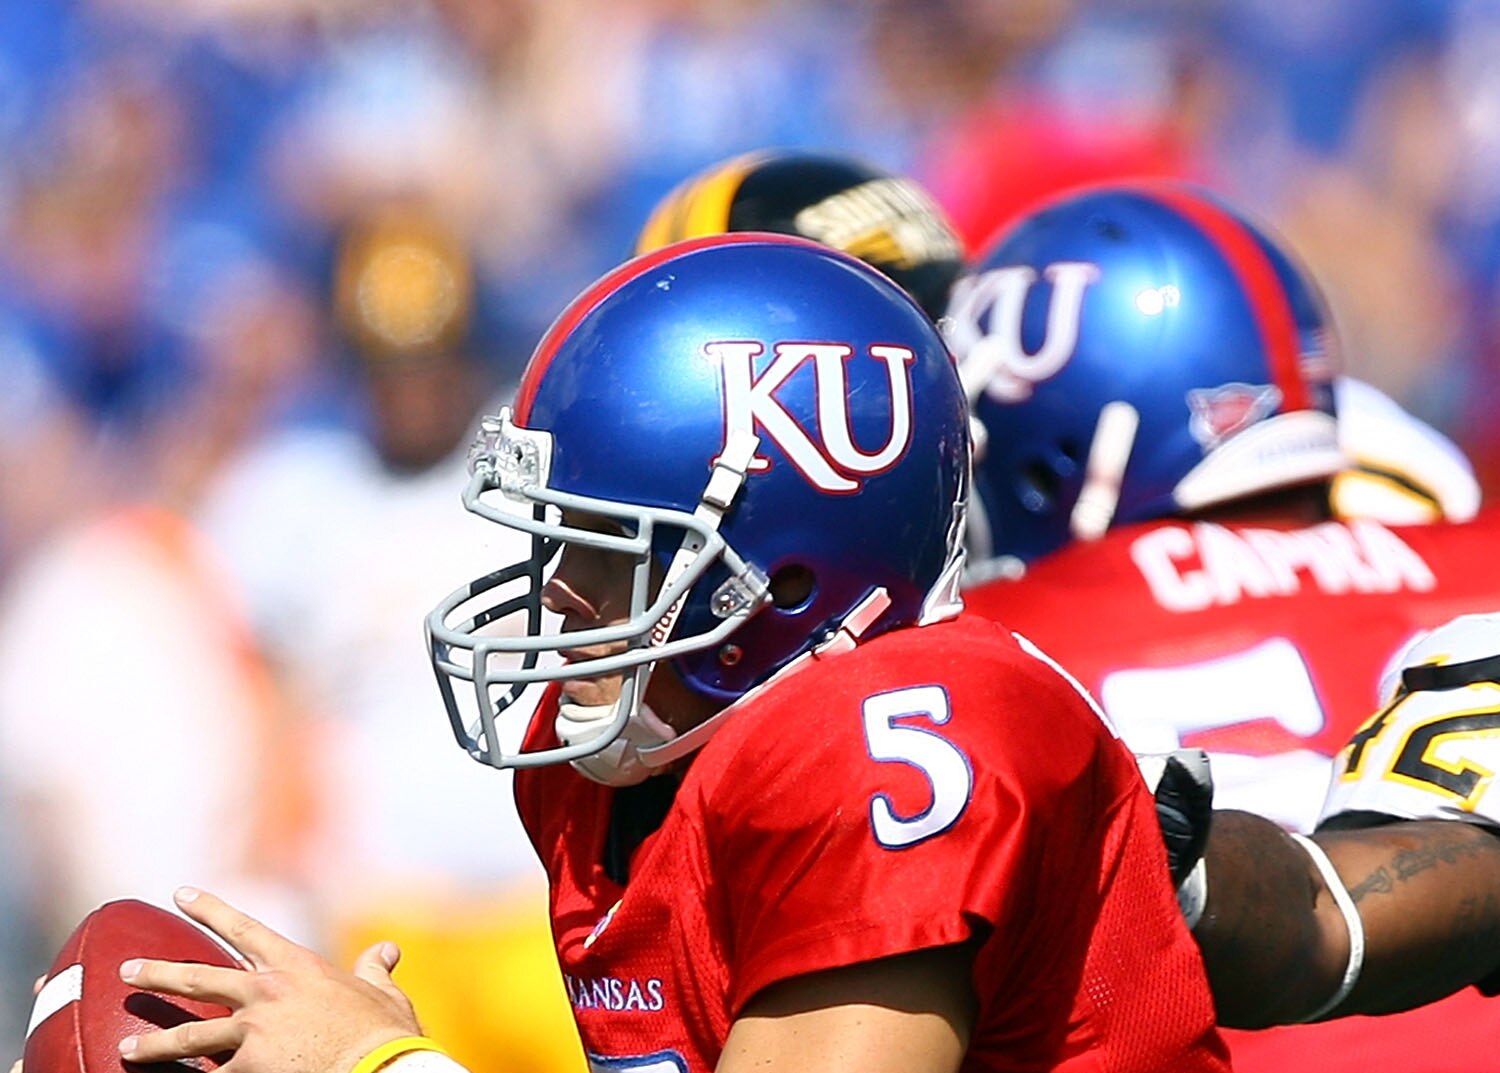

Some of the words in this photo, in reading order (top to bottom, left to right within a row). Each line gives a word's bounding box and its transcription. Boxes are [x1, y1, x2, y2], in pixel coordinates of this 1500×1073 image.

[704, 340, 916, 494] KU
[1130, 519, 1438, 613] CAPRA
[861, 683, 974, 850] 5
